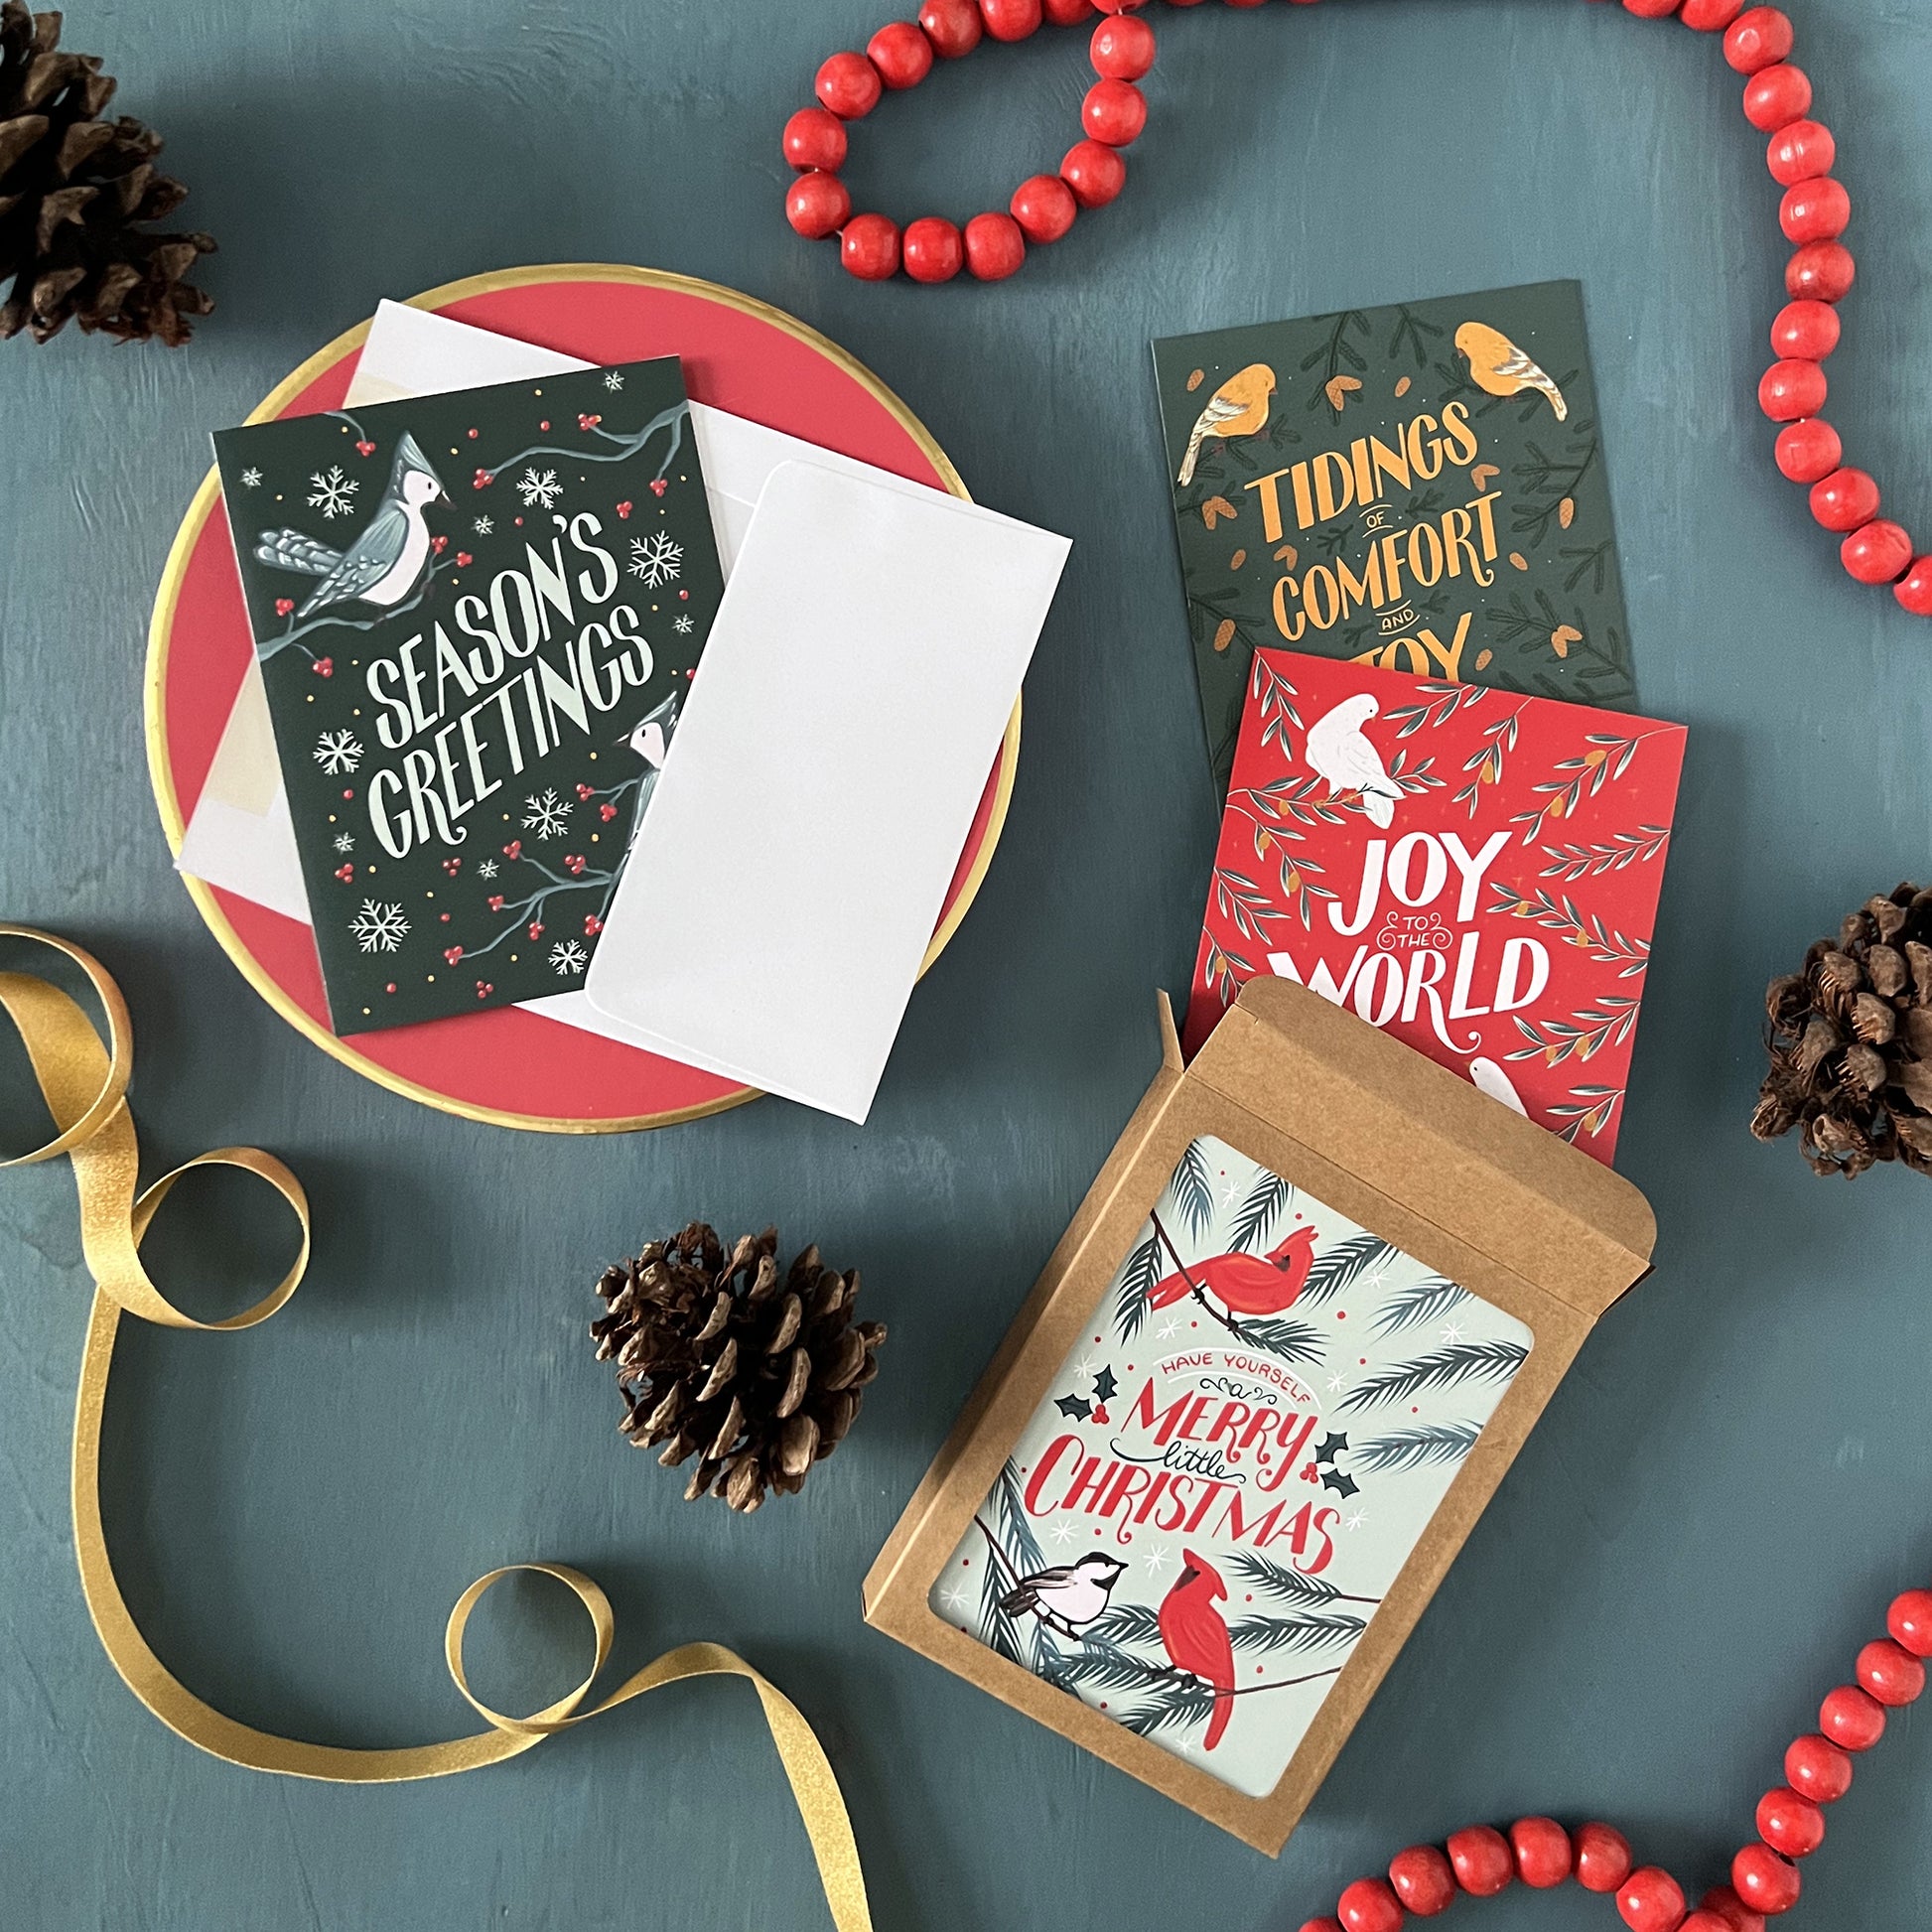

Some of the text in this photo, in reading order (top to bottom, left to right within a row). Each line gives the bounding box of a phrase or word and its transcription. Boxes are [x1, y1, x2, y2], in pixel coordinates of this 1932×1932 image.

[1244, 401, 1478, 543] TIDINGS
[1366, 511, 1385, 528] OF
[1272, 490, 1502, 641] COMFORT
[366, 512, 619, 749] SEASON'S
[1348, 612, 1473, 682] OY
[1381, 608, 1414, 629] AND
[368, 605, 653, 859] GREETINGS
[1327, 831, 1513, 936] JOY
[1403, 915, 1429, 931] TO
[1266, 931, 1550, 1054] WORLD
[1397, 933, 1430, 947] THE
[1162, 1352, 1311, 1404] HAVE YOURSELF
[1110, 1438, 1247, 1484] little
[1121, 1377, 1318, 1491] MERRY
[1025, 1434, 1340, 1575] CHRISTMAS
